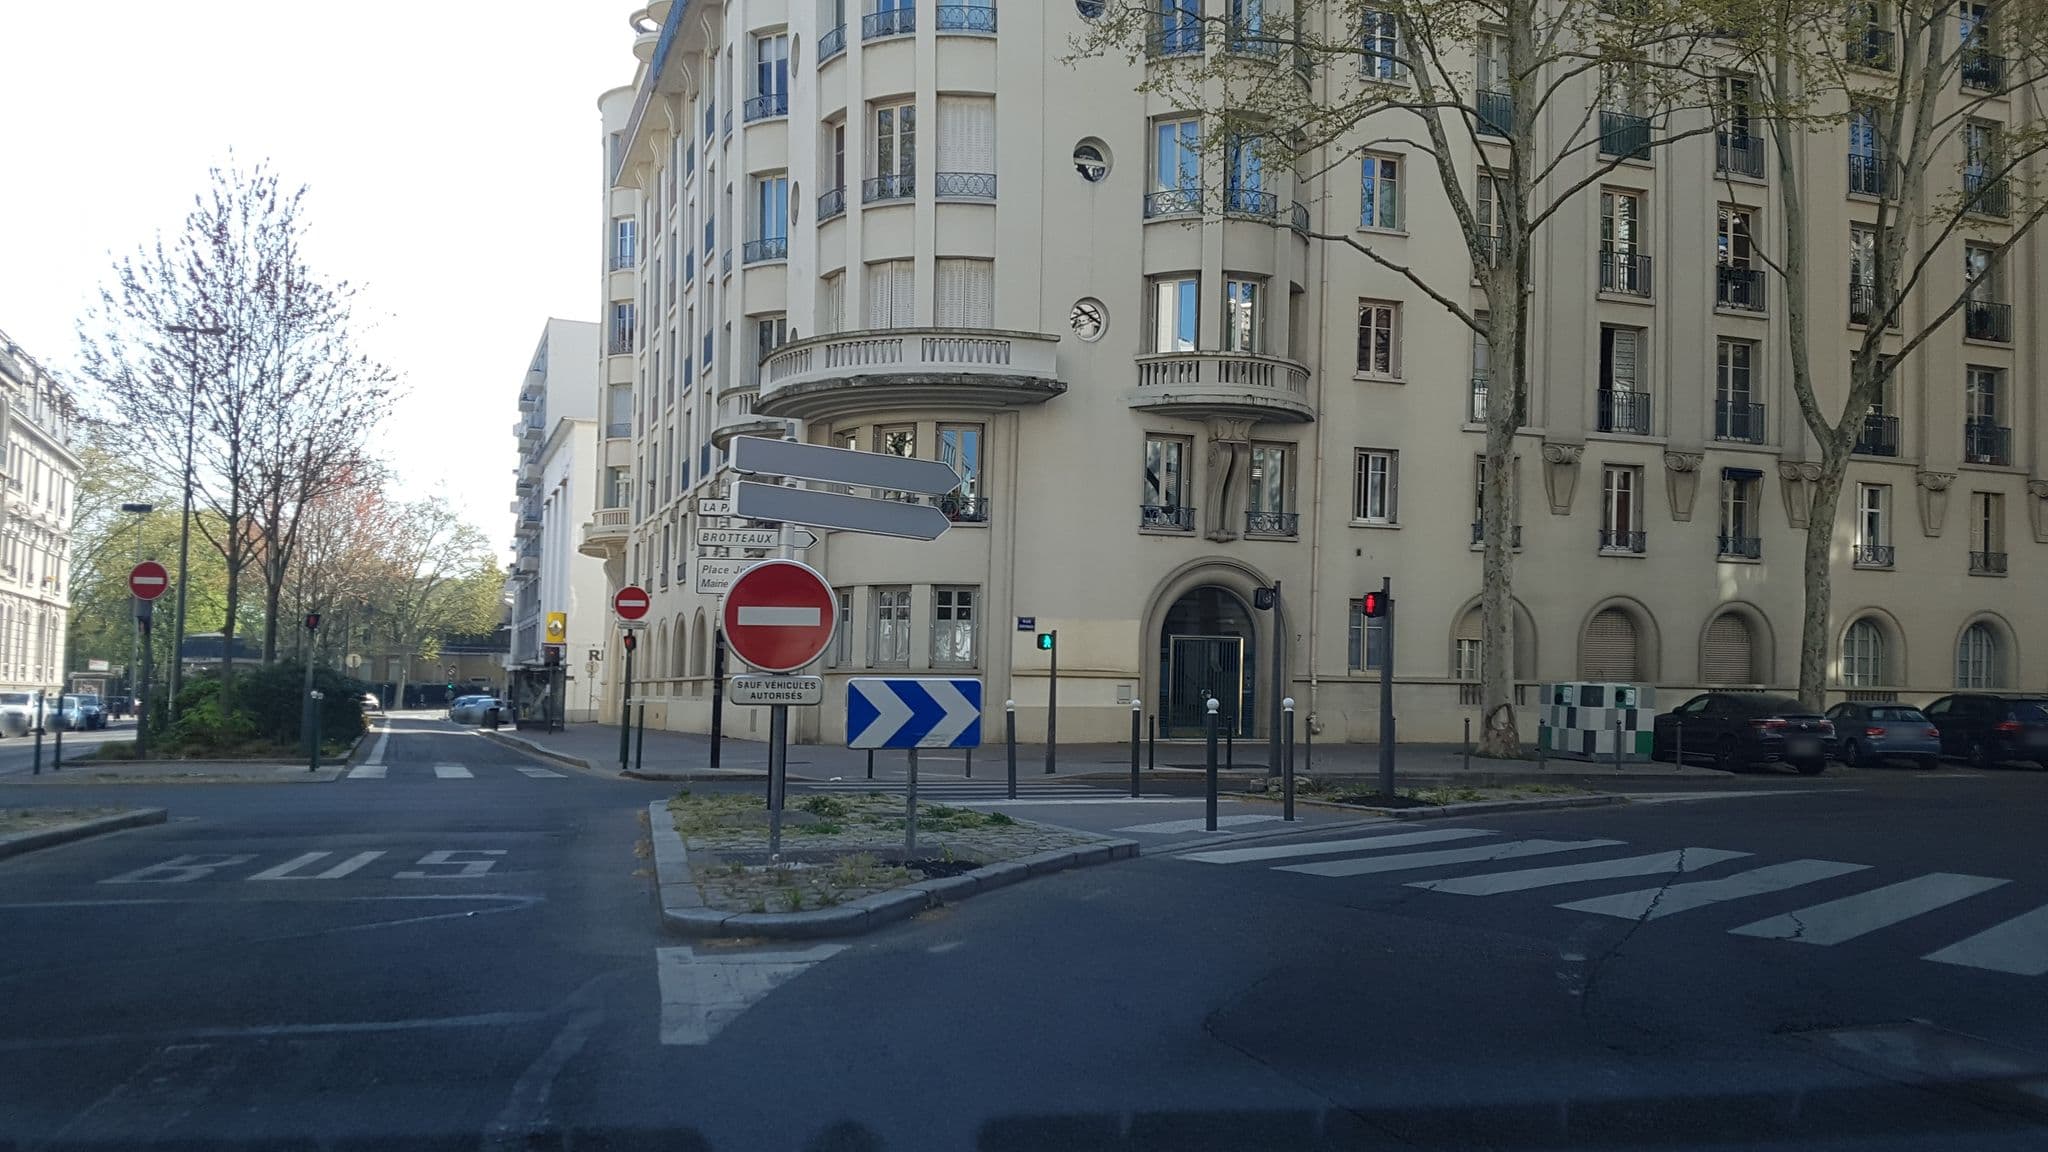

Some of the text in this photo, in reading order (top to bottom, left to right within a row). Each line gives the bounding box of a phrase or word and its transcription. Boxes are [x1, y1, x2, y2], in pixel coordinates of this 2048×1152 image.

[703, 503, 716, 512] LA
[702, 532, 773, 543] BROTTEAUX
[701, 564, 729, 574] Place
[701, 578, 729, 588] Mairie
[737, 680, 816, 690] SAUF VÉHICULES
[750, 690, 802, 700] AUTORISÉS
[96, 850, 508, 884] BUS
